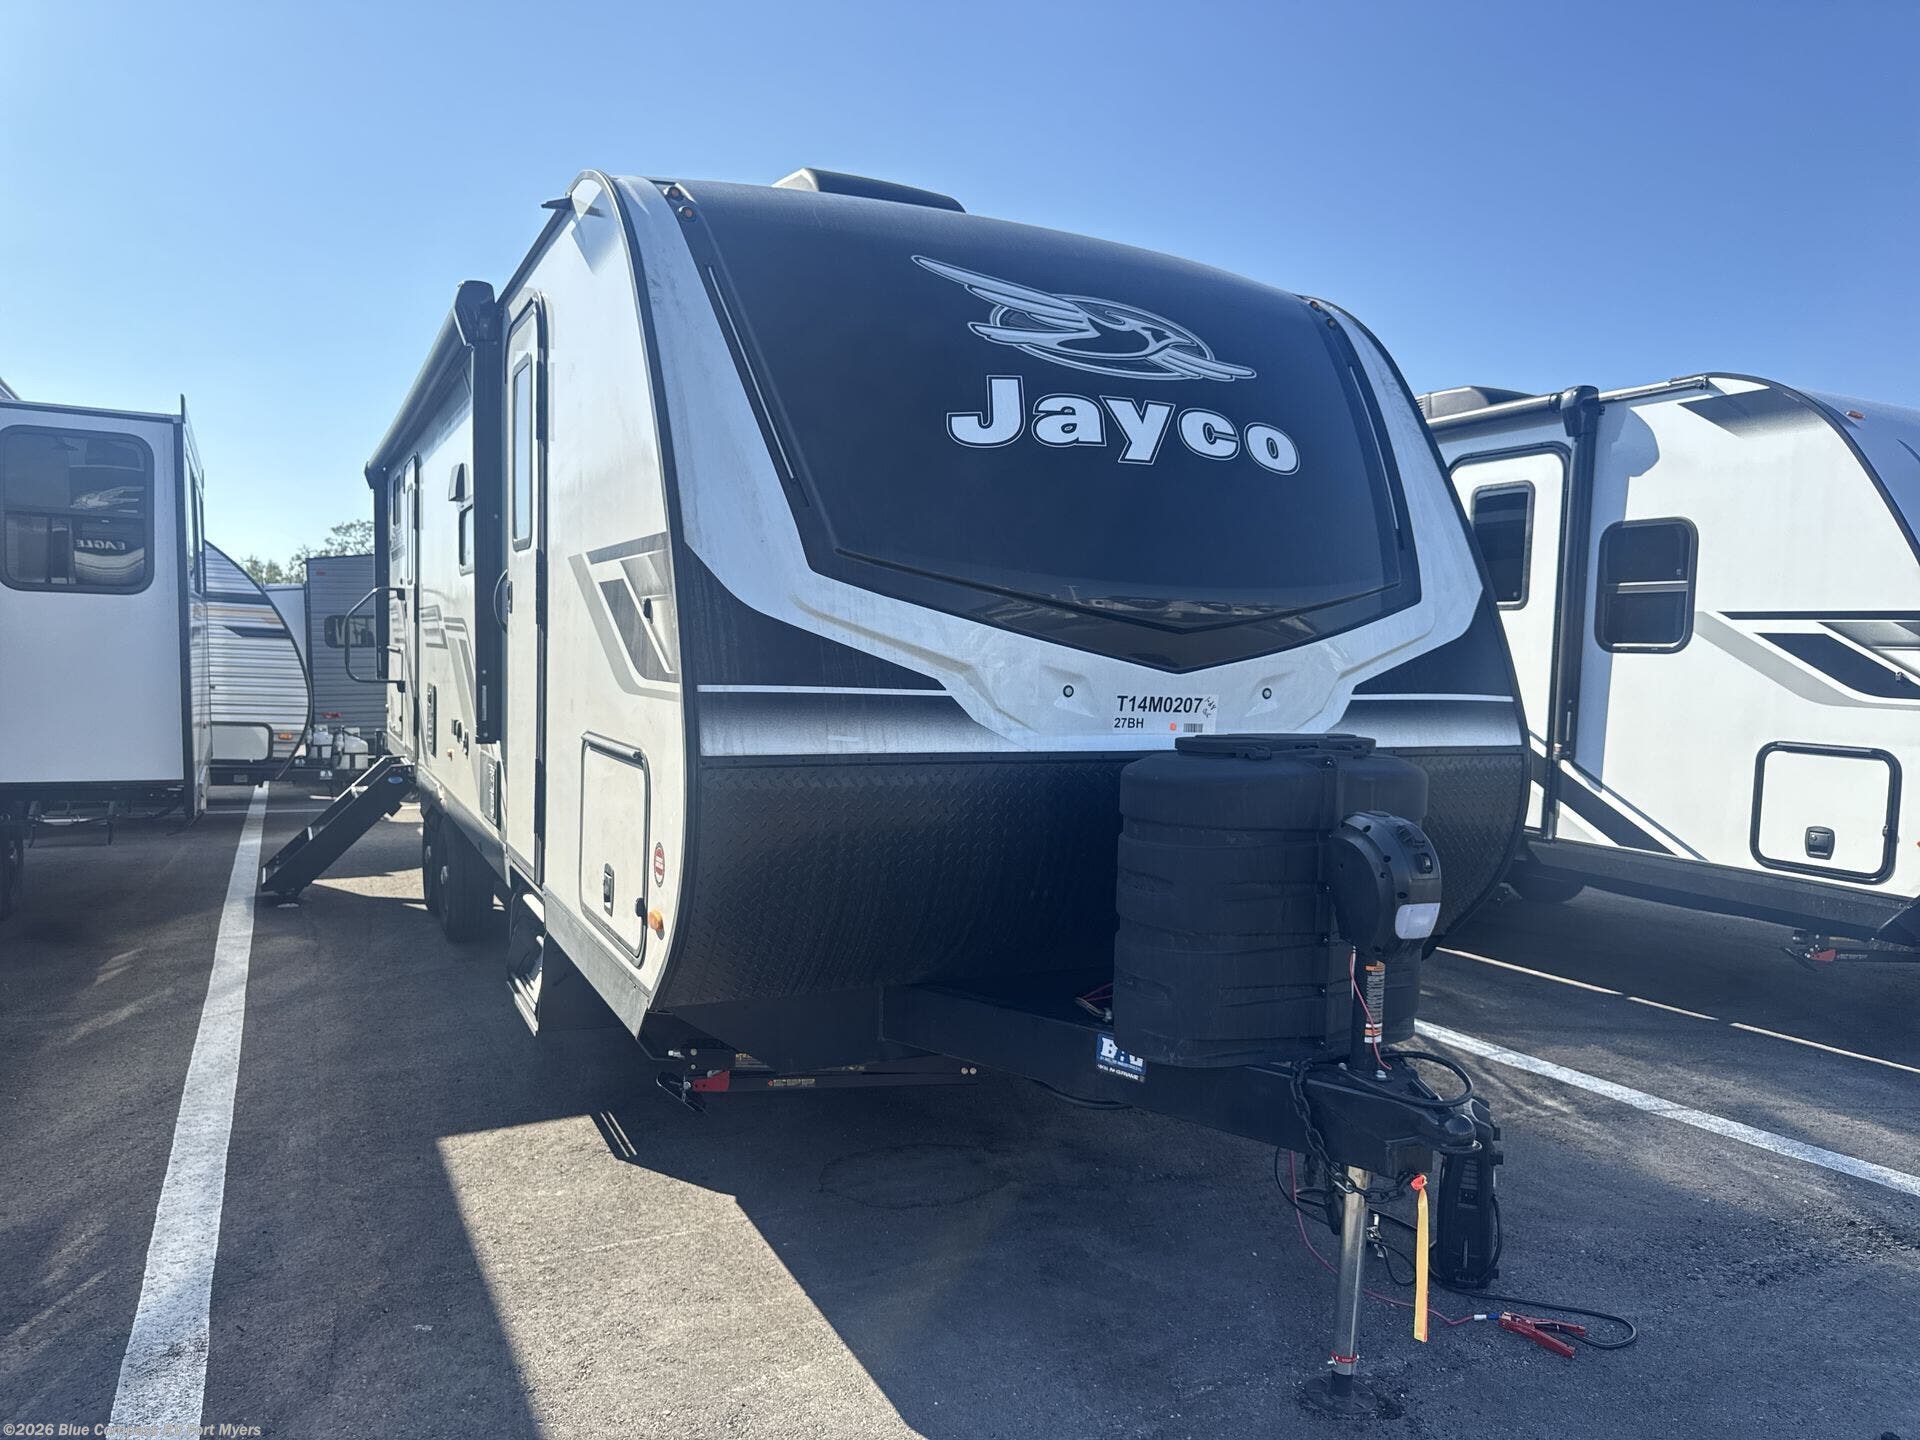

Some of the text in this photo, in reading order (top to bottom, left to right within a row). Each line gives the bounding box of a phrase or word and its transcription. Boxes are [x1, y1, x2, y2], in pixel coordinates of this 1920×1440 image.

[947, 375, 1300, 475] Jayco
[1117, 696, 1203, 713] T14M0207
[1114, 718, 1144, 729] 27BH
